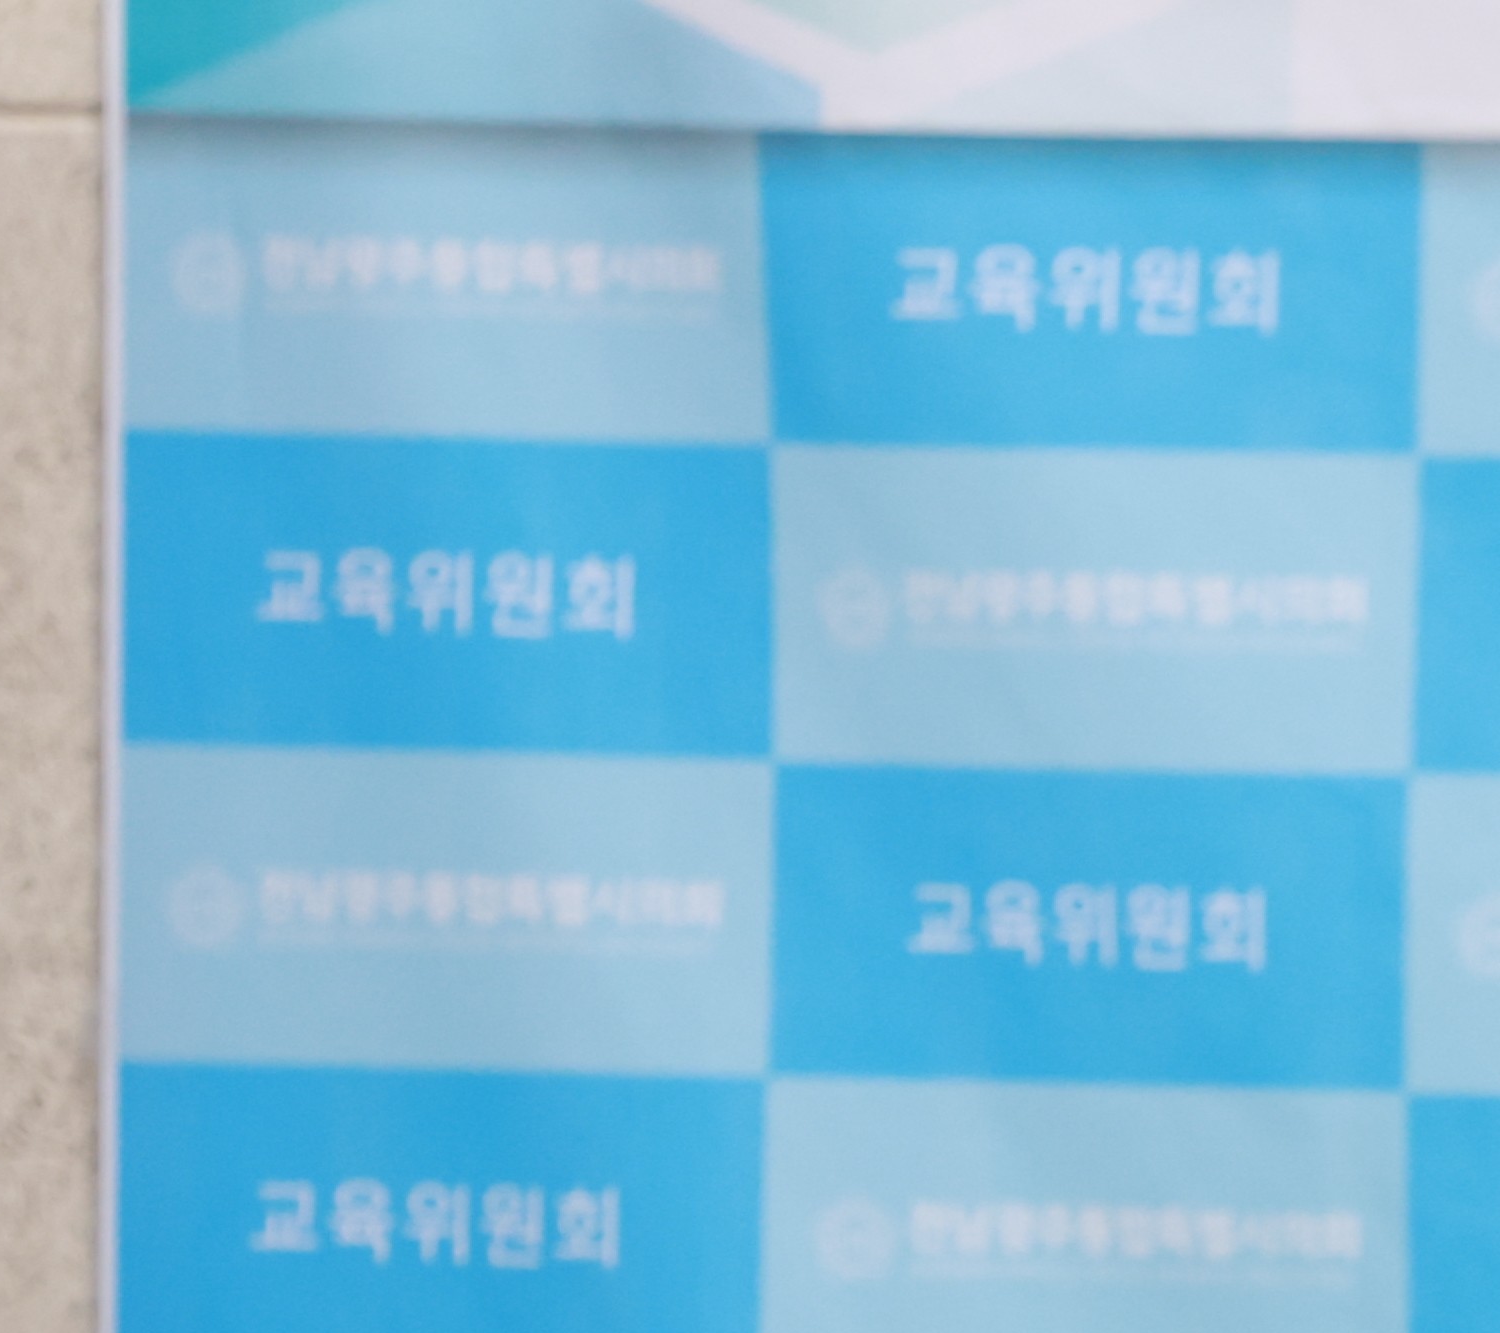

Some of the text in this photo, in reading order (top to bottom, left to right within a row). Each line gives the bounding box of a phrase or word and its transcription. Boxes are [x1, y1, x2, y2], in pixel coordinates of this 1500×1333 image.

[894, 242, 1283, 339] 교육위원회
[257, 546, 639, 643] 교육위원회
[907, 878, 1270, 974] 교육위원회
[250, 1175, 624, 1272] 교육위원회
